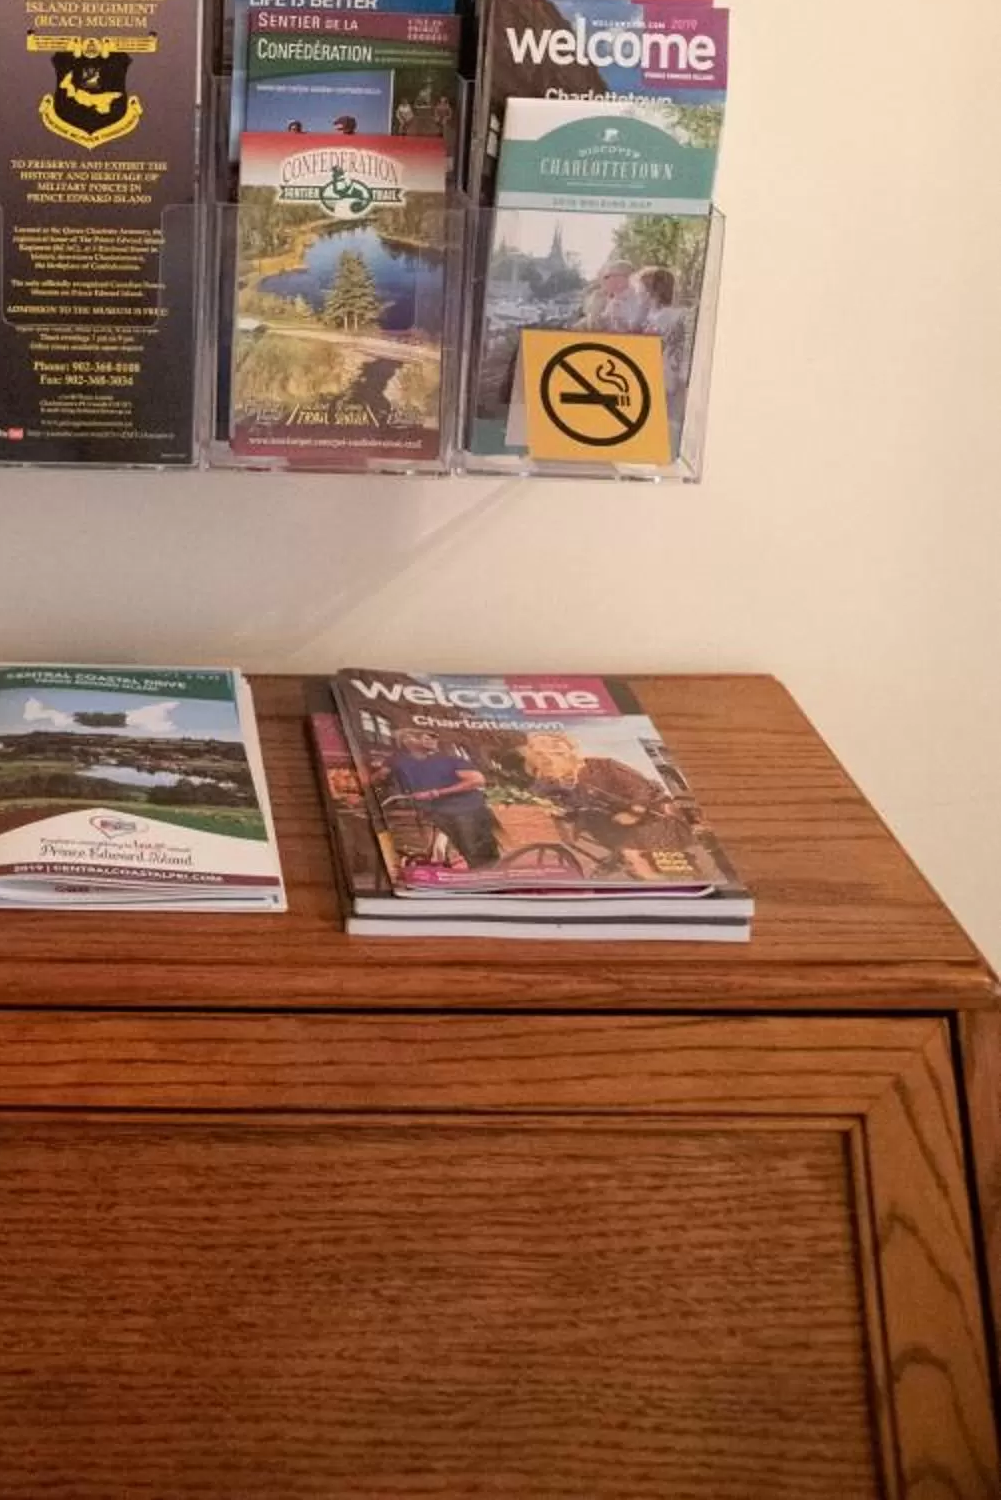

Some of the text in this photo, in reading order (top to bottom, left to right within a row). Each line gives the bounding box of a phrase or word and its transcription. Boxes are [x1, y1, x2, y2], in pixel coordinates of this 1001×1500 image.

[26, 3, 157, 14] ISLAND REGIMENT
[34, 15, 148, 28] (RCAC) MUSEUM
[258, 11, 359, 31] SENTIER DE LA
[671, 19, 698, 32] 2019
[505, 12, 717, 71] welcome
[257, 37, 373, 63] CONFÉDÉRATION
[545, 86, 673, 106] Charlottetown
[10, 160, 25, 170] TO
[28, 160, 78, 170] PRESERVE
[80, 160, 101, 170] AND
[282, 150, 399, 184] CONFEDERATION
[540, 158, 675, 181] CHARLOTTETOWN
[20, 171, 62, 181] HISTORY
[66, 171, 89, 181] AND
[91, 171, 141, 182] HERITAGE
[37, 182, 142, 192] MILITARY FORCES IN
[27, 193, 152, 204] PRINCE EDWARD ISLAND
[33, 361, 70, 373] Phone:
[75, 673, 137, 684] COASTAL
[142, 678, 187, 689] DRIVE
[351, 678, 601, 709] welcome
[412, 714, 566, 731] Charlottetown
[39, 844, 87, 859] Prince
[89, 847, 145, 863] Edward
[147, 851, 194, 866] Island
[13, 864, 44, 874] 2019
